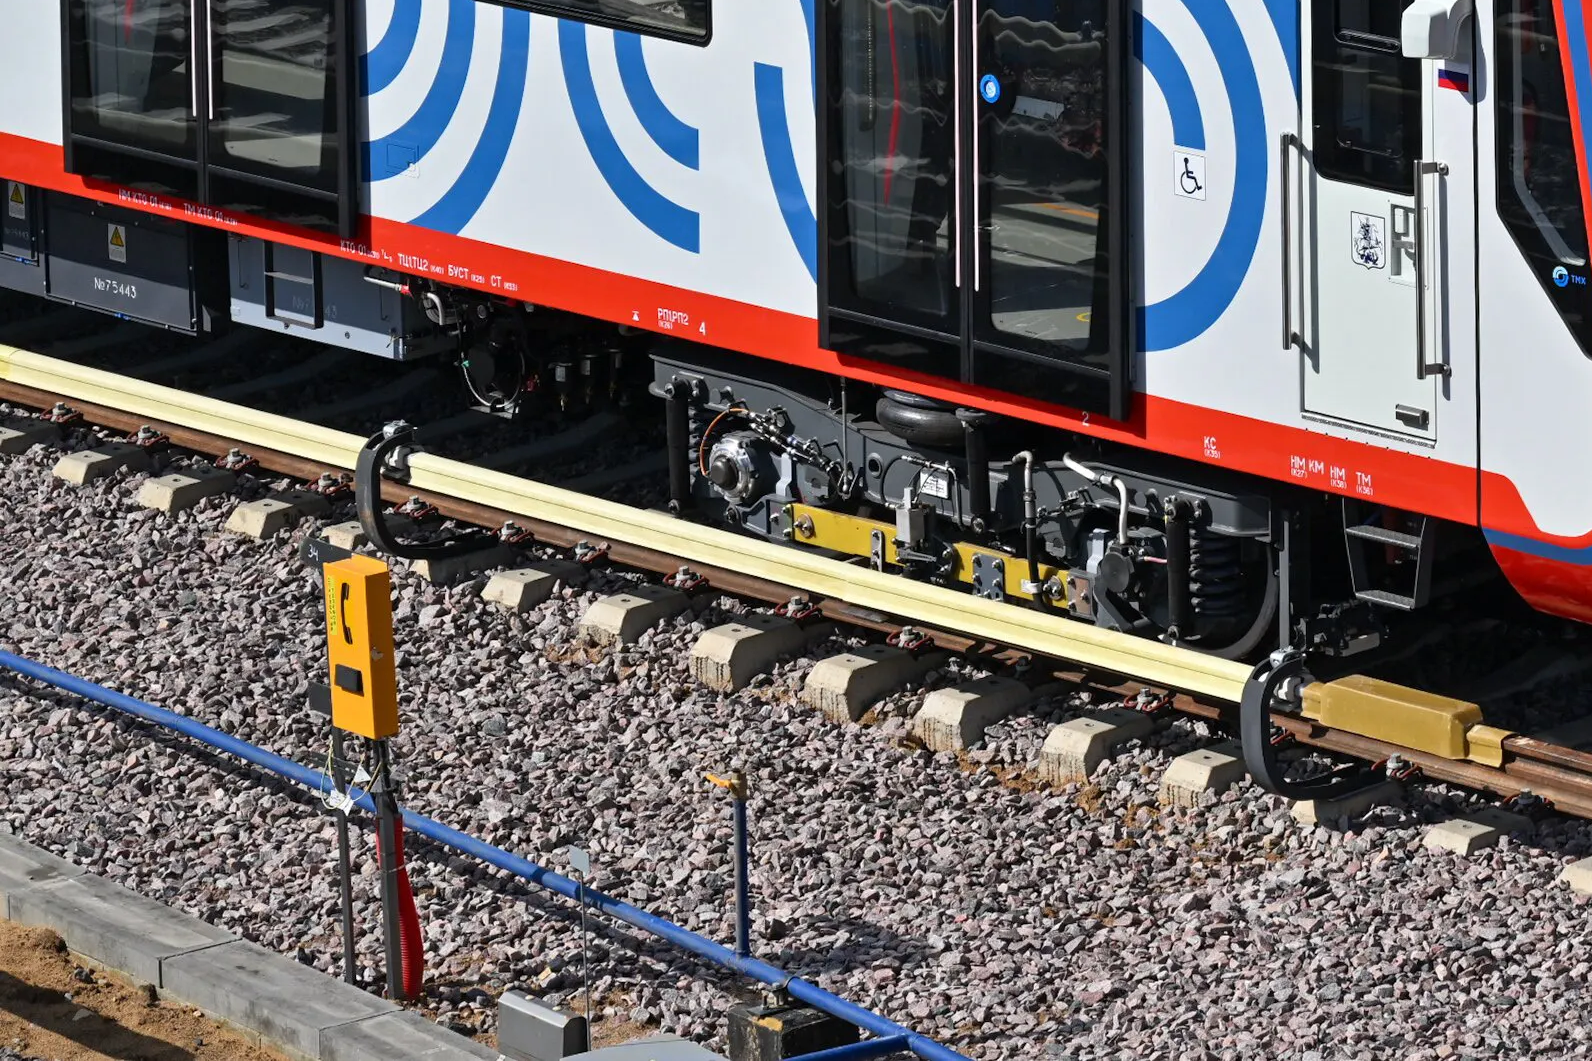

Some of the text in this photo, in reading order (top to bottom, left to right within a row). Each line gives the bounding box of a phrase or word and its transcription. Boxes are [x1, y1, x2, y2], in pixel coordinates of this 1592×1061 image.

[340, 239, 356, 255] КТО
[448, 264, 469, 282] БУСТ
[490, 275, 502, 289] СТ
[94, 277, 137, 299] №75443
[699, 321, 706, 336] 4
[1082, 410, 1089, 426] 2
[1203, 435, 1217, 450] КС
[1290, 454, 1371, 488] НМ КМ НМ ТМ
